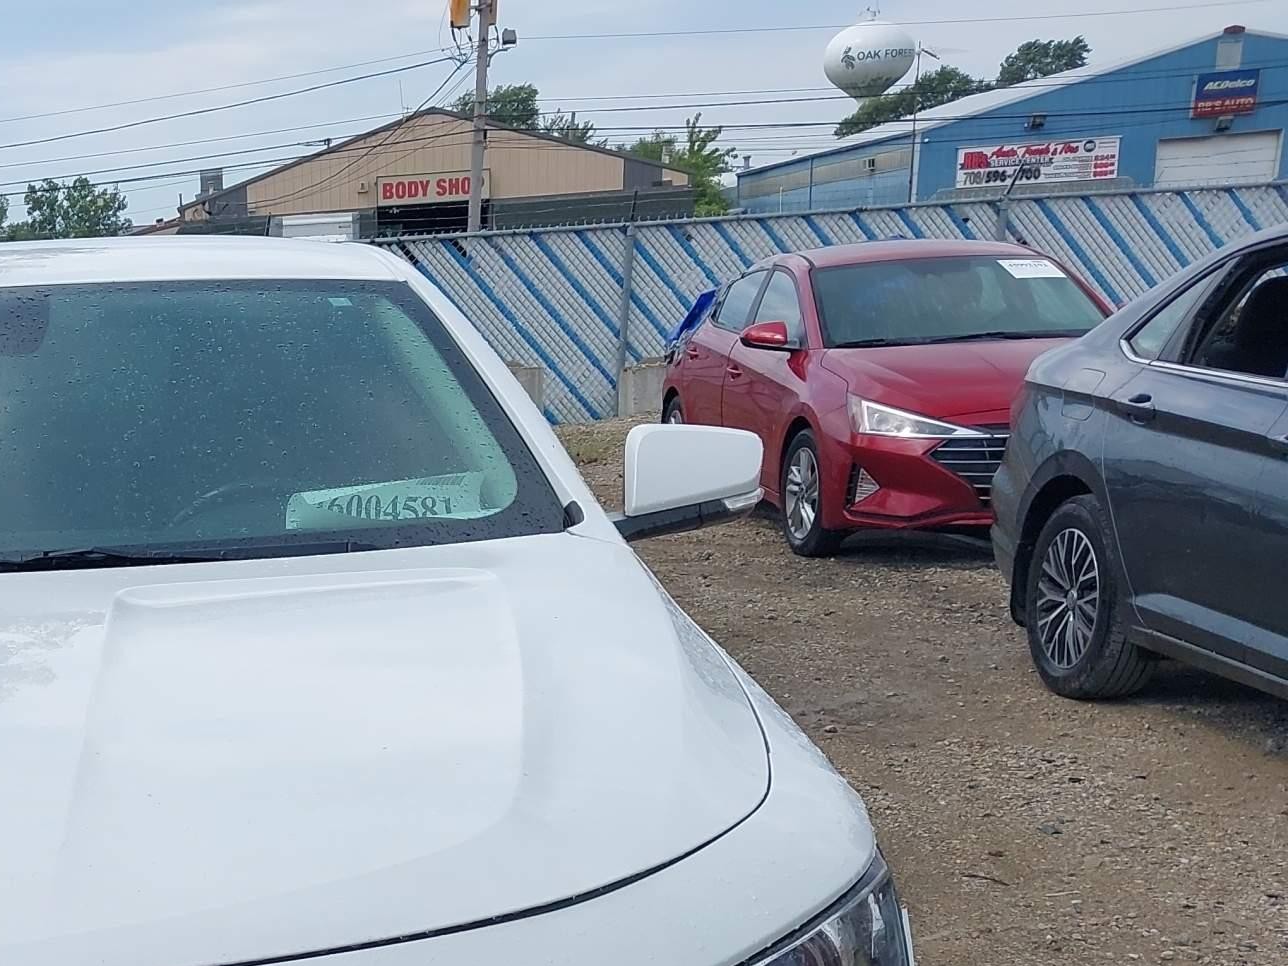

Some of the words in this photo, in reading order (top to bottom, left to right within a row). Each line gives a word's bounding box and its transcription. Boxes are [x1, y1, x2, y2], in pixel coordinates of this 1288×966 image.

[857, 49, 881, 61] OAK
[1204, 79, 1255, 90] ACDelco
[990, 158, 1021, 168] SERVICE
[382, 180, 430, 200] BODY
[436, 176, 485, 197] SHO
[316, 494, 453, 520] 6004581
